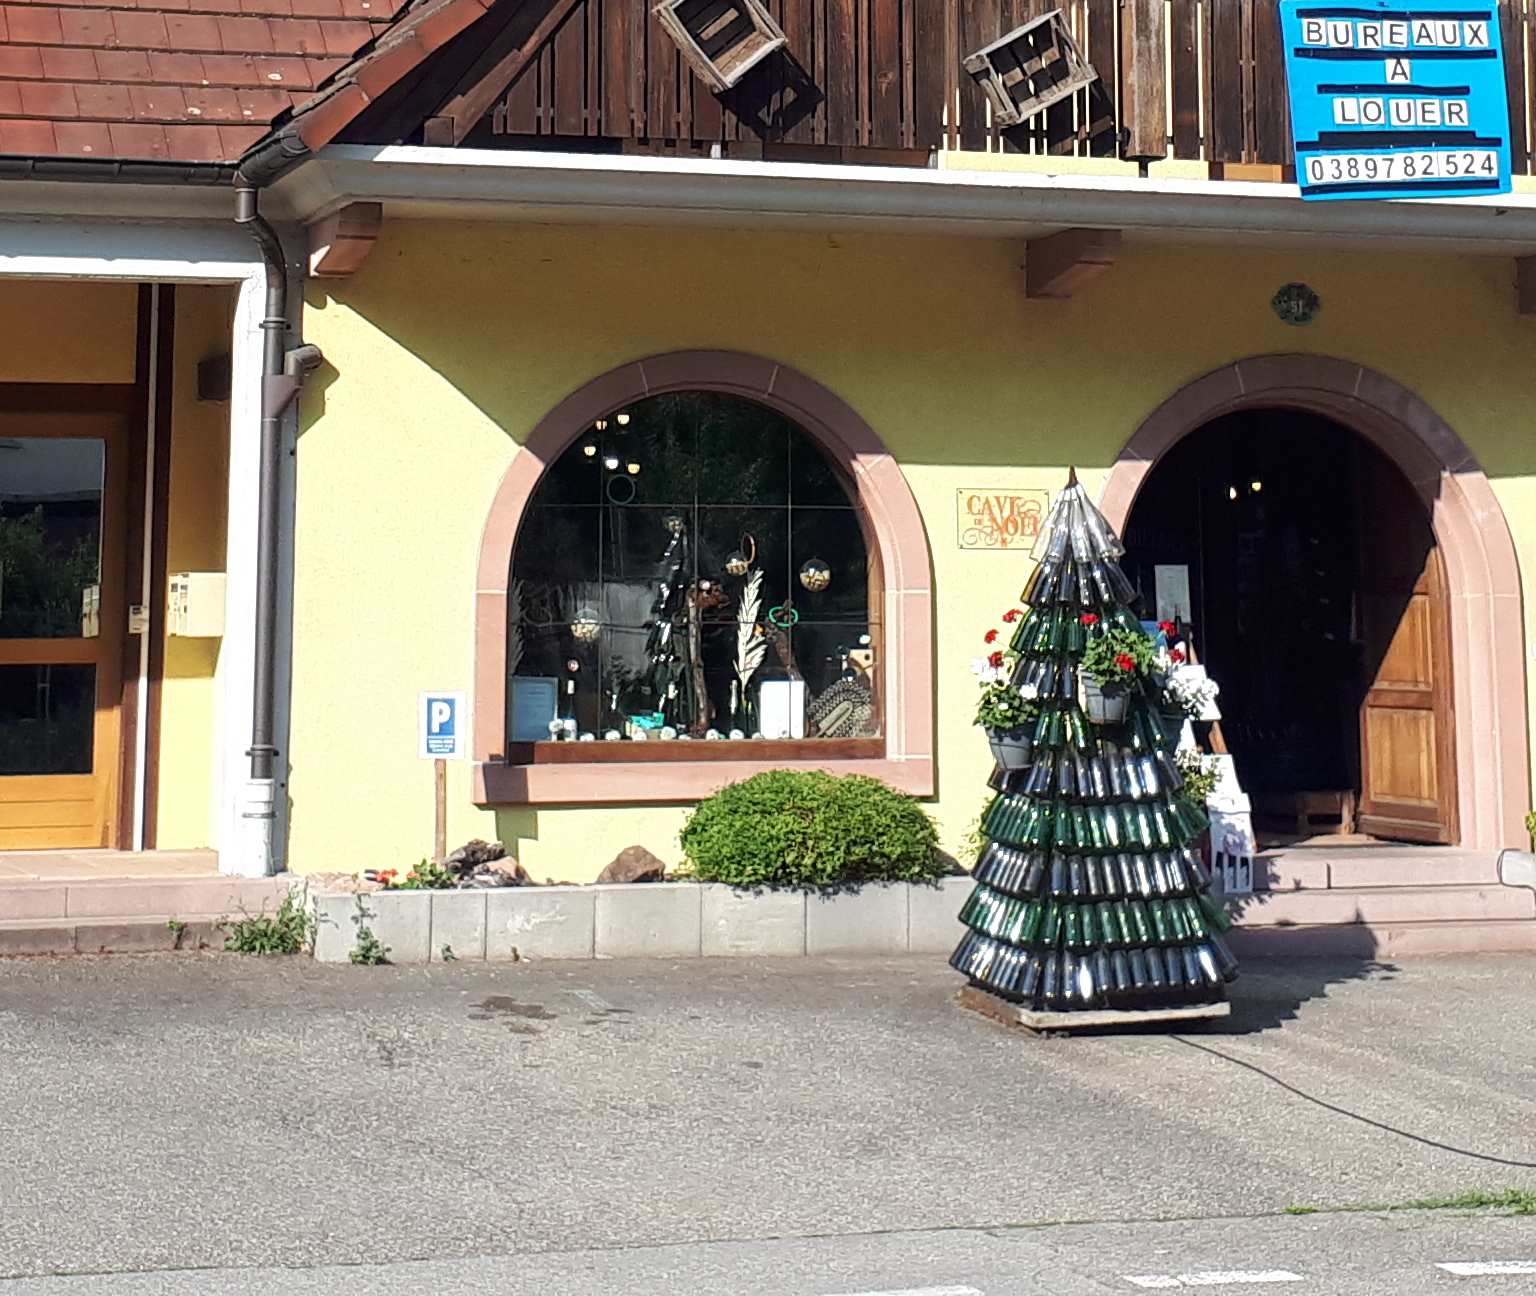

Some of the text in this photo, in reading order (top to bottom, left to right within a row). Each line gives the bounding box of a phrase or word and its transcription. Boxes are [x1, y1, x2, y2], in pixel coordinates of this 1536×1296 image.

[1306, 21, 1485, 47] BUREAUX
[1390, 58, 1409, 81] A
[1341, 100, 1466, 124] LOUER
[1311, 153, 1495, 182] 0389782524
[431, 701, 451, 733] P
